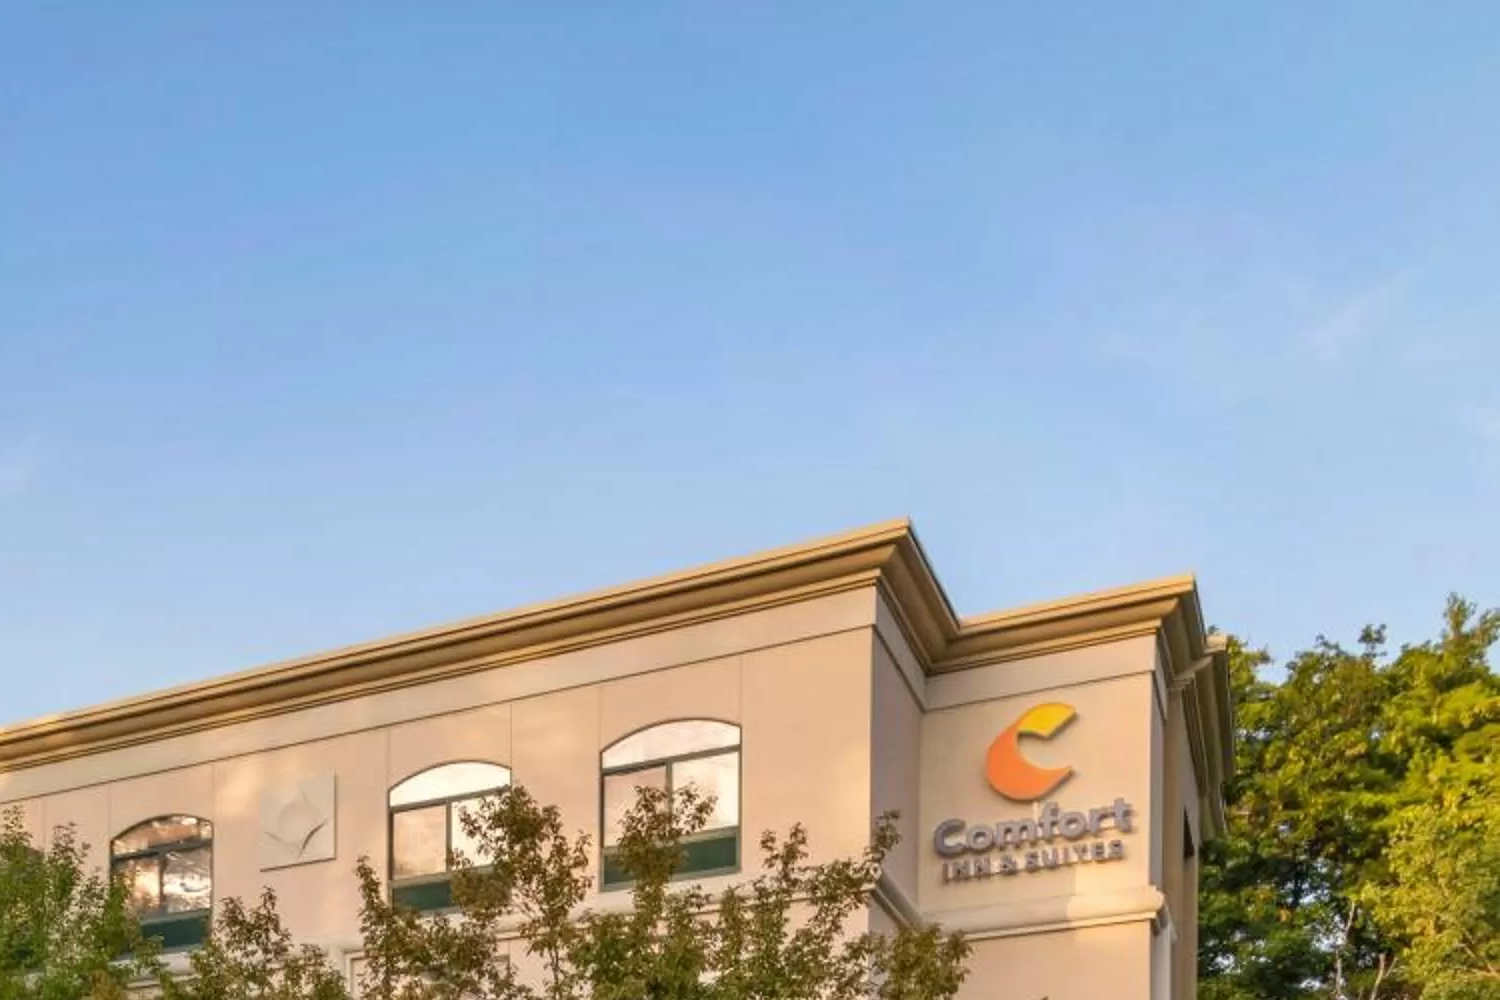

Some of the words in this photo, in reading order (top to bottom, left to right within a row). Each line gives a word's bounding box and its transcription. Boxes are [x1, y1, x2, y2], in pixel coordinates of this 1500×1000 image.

[934, 798, 1134, 858] Comfort
[943, 855, 991, 884] INN
[1025, 839, 1126, 871] SUITES
